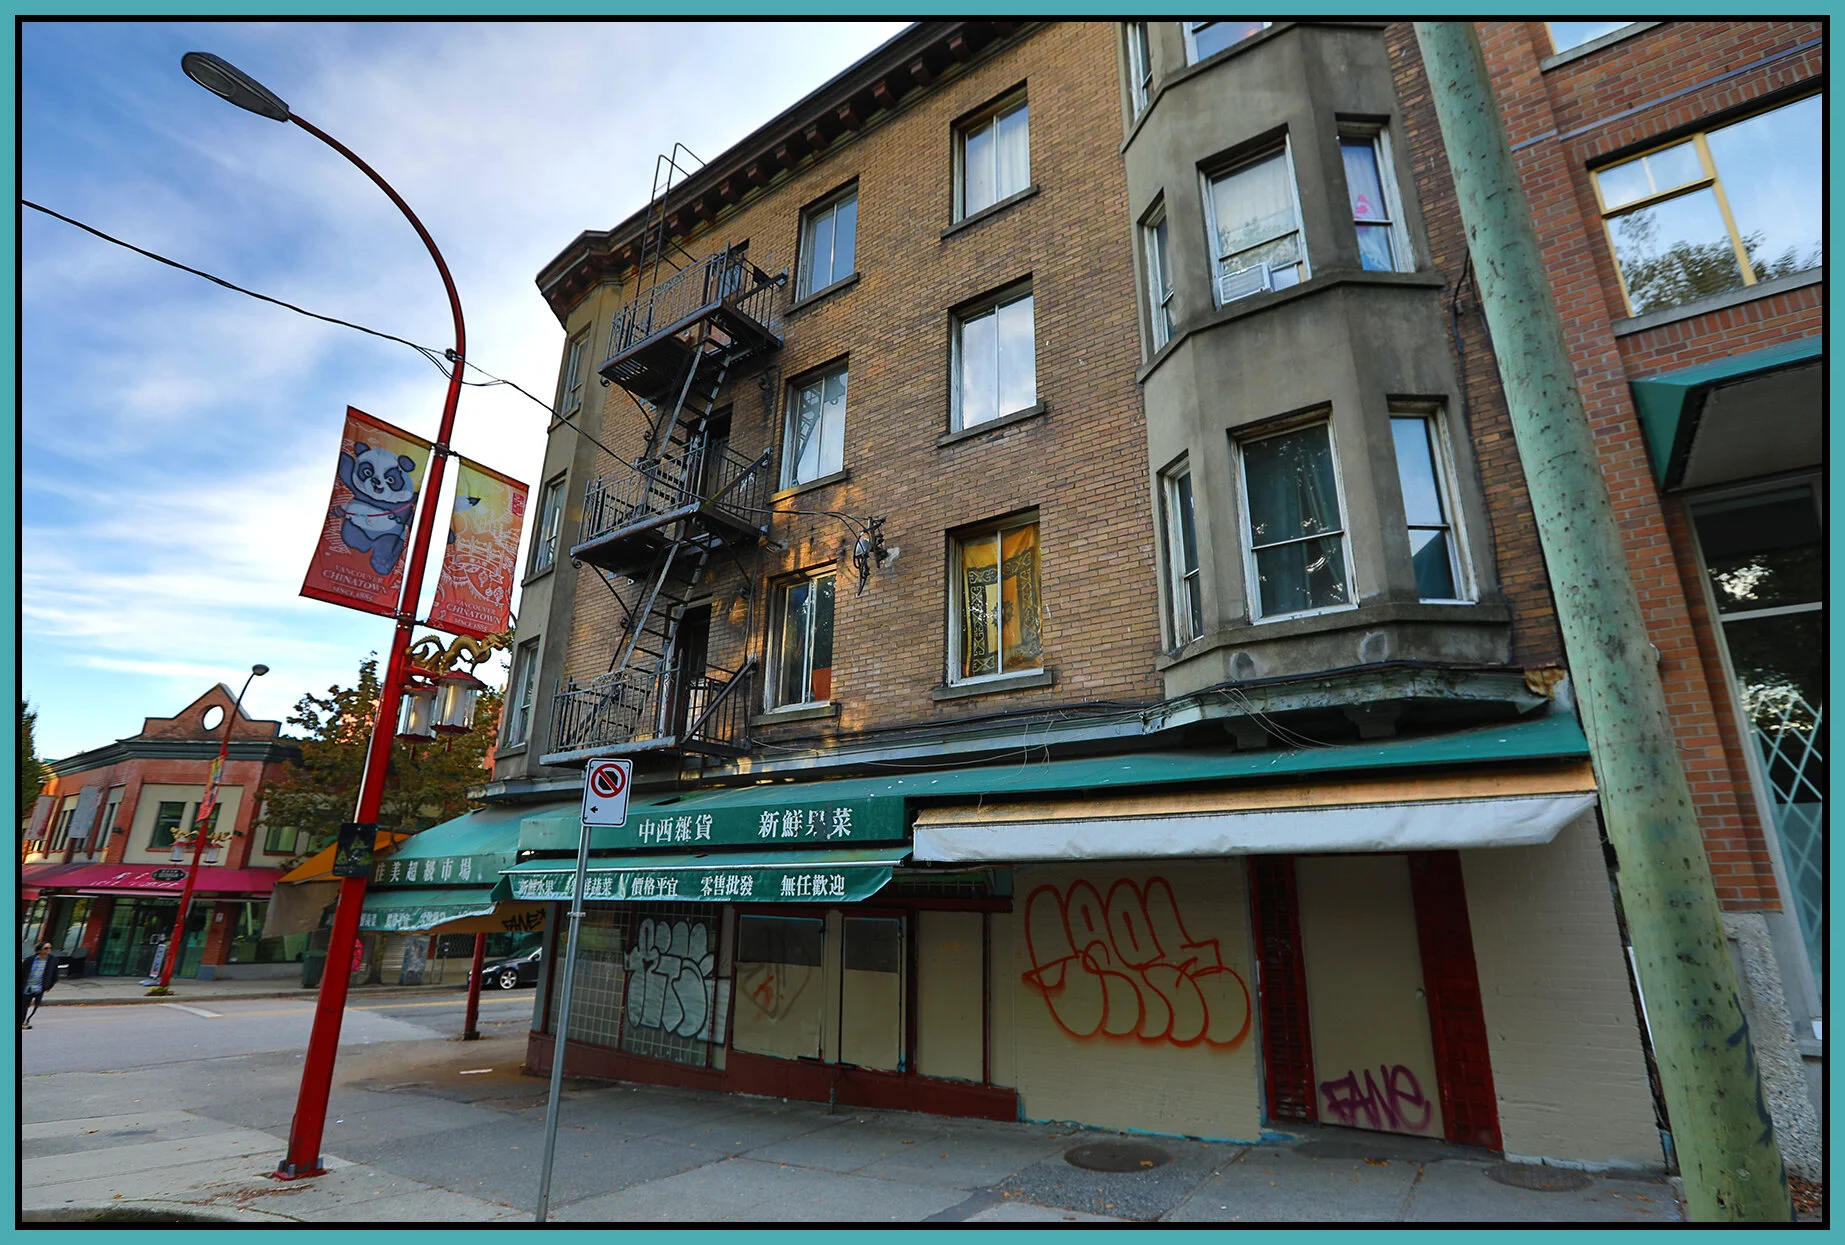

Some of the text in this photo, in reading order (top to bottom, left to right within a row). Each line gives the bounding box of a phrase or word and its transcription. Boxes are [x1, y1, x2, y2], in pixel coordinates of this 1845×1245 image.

[322, 569, 388, 594] CHINATOWN
[335, 565, 384, 584] VANCOUVER
[332, 586, 354, 597] SINCE
[446, 603, 501, 624] CHINATOWN
[456, 600, 496, 615] VANCOUVER
[455, 618, 472, 627] SINCE
[638, 813, 713, 844] 中西雜貨
[631, 877, 678, 896] 價格平宜
[700, 875, 754, 896] 零售批發
[780, 874, 846, 896] 無任歡迎
